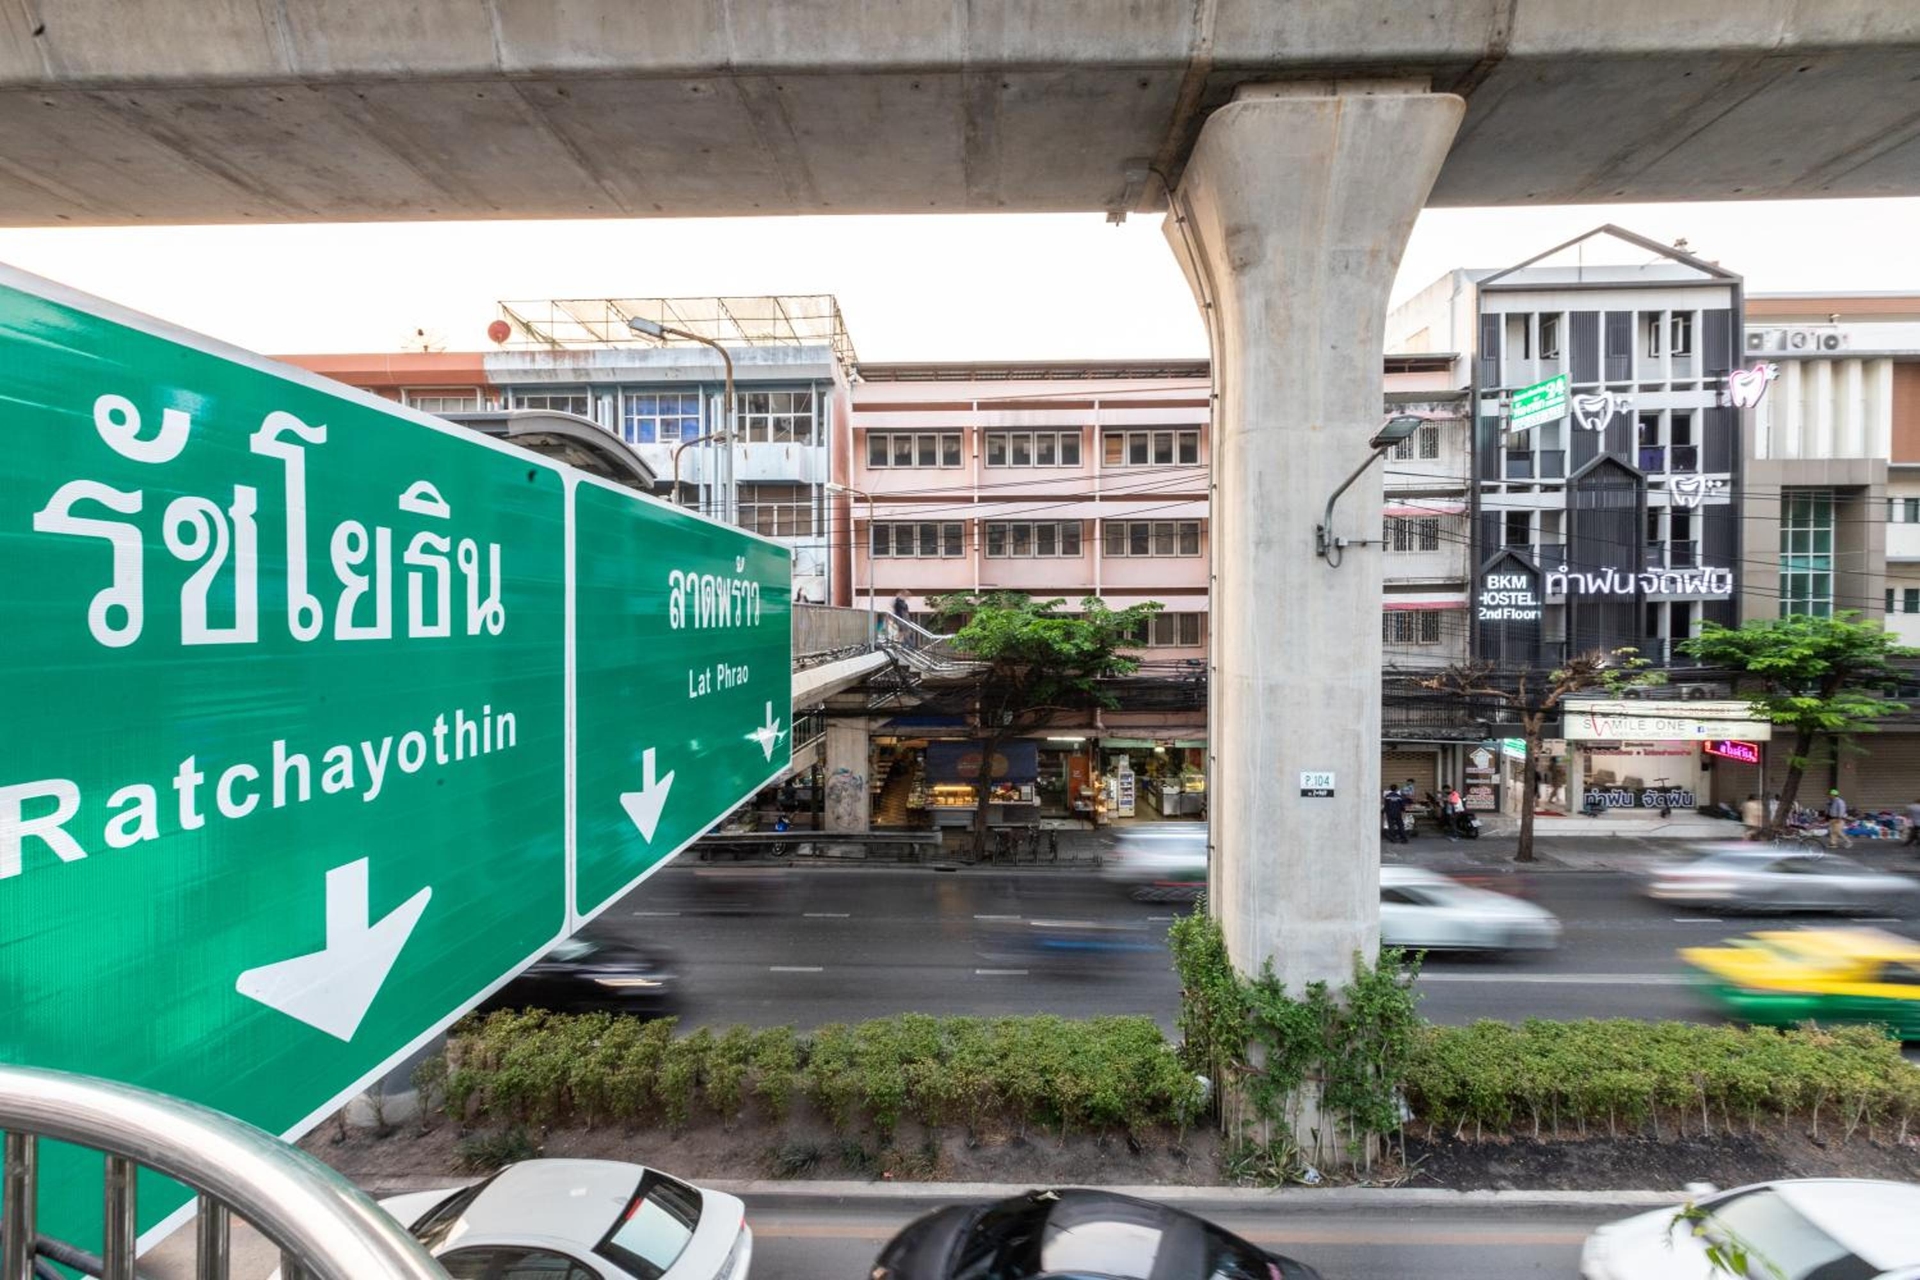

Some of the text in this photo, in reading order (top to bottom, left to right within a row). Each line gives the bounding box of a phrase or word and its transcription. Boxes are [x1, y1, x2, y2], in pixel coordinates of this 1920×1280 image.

[33, 394, 505, 648] รัชโยธิน
[668, 555, 760, 630] ลาดพร้าว
[1487, 575, 1527, 589] BKM
[1478, 607, 1537, 620] 2nd Floor
[689, 663, 749, 699] Lat Phrao
[1655, 718, 1686, 731] ONE
[0, 704, 517, 879] Ratchayothin
